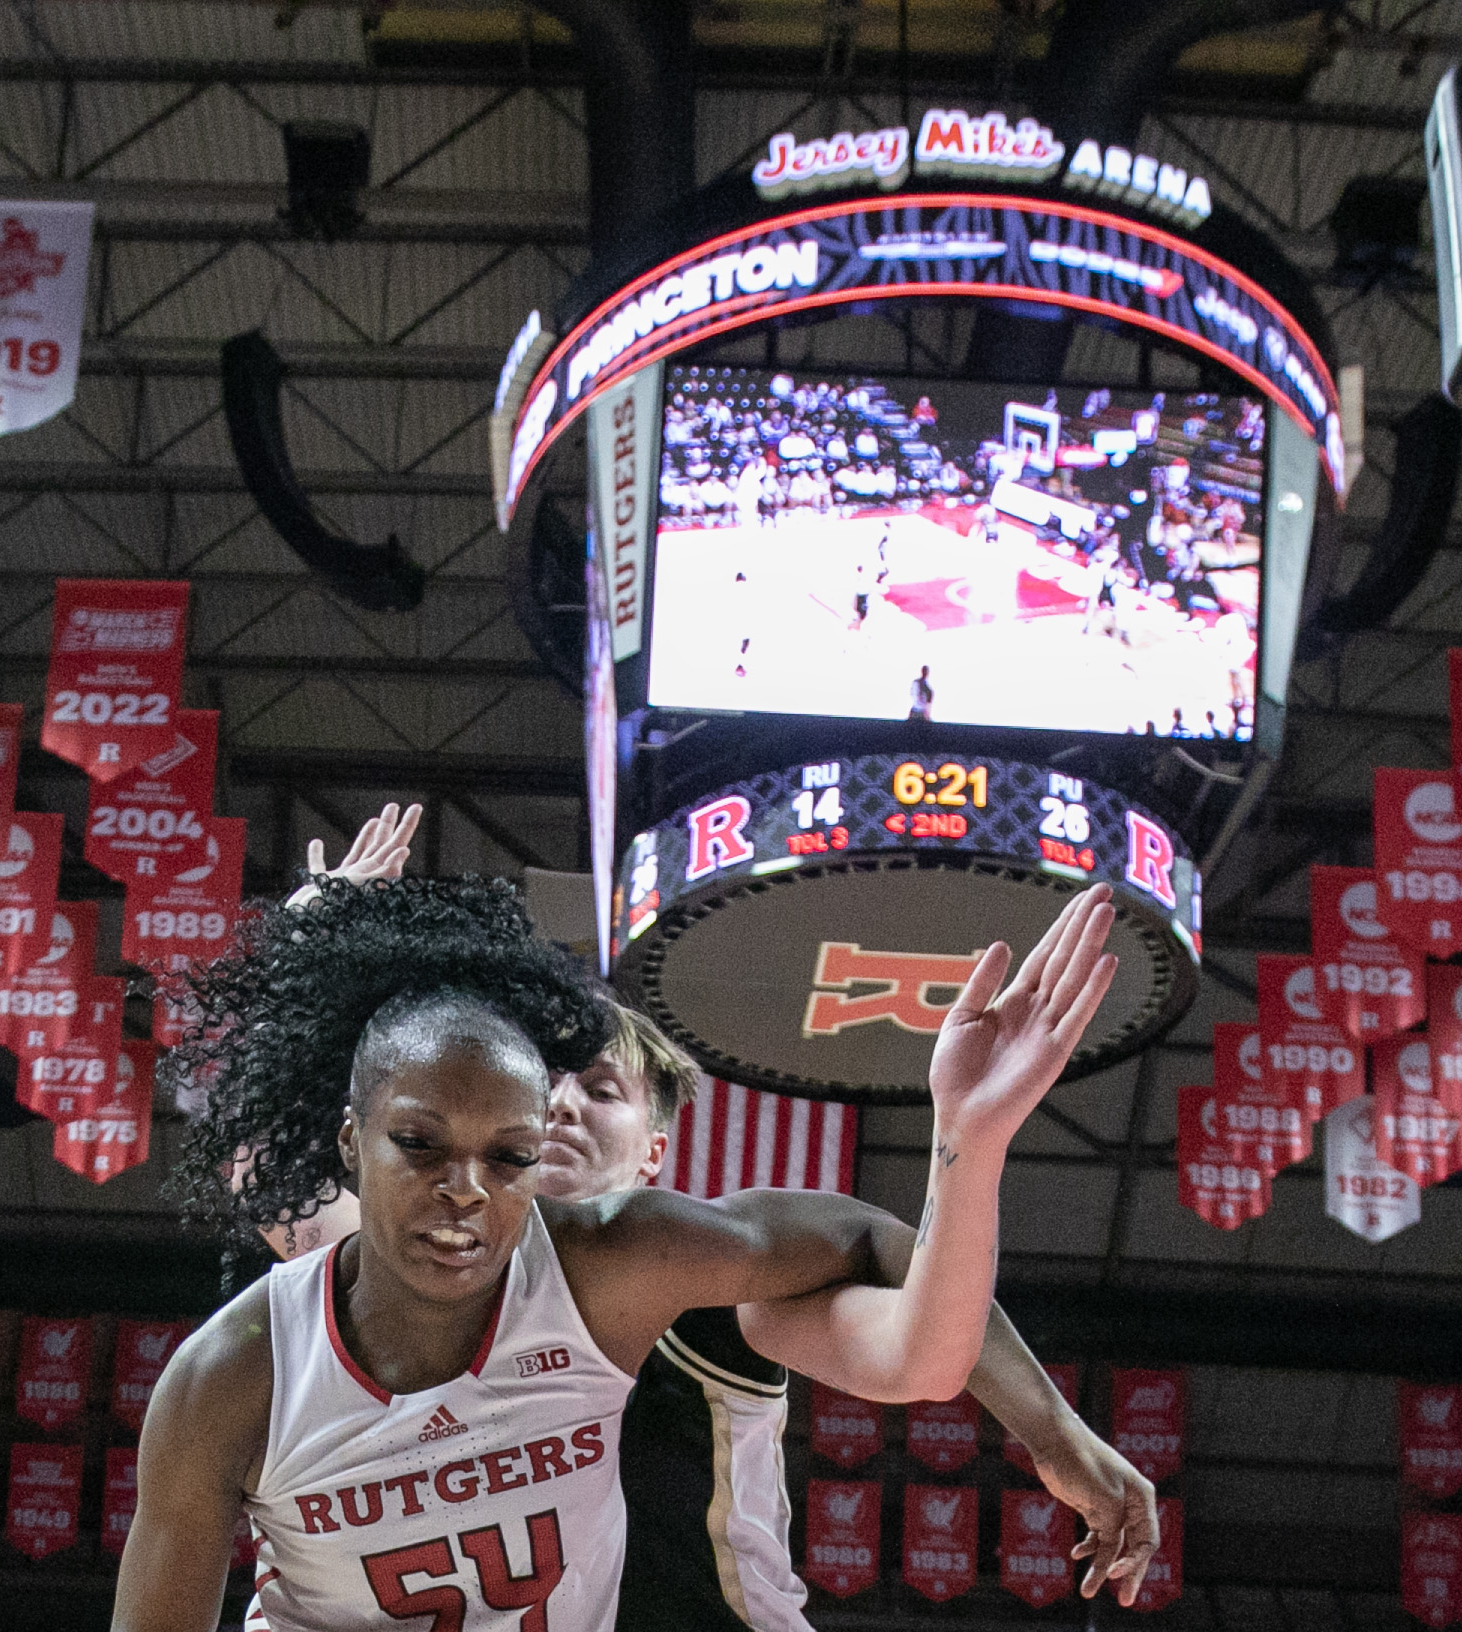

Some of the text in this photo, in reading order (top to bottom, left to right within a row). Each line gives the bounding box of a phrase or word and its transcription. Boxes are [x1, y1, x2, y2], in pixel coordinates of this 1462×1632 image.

[752, 127, 908, 184] Jersey
[1069, 140, 1212, 218] ARENA
[566, 240, 819, 400] PRINCETON
[613, 396, 636, 628] RUTGERS
[52, 690, 171, 724] 2022
[802, 762, 840, 789] RU
[893, 762, 987, 807] 6:21
[1048, 771, 1083, 802] PU
[91, 806, 204, 839] 2004
[791, 786, 844, 829] 14
[1039, 796, 1089, 843] 26
[686, 795, 754, 882] R
[910, 813, 967, 838] 2ND
[1126, 810, 1177, 909] R
[134, 910, 226, 940] 1989
[1322, 963, 1412, 997] 1992
[1267, 1044, 1354, 1075] 1990
[1337, 1175, 1407, 1199] 1982
[418, 1420, 469, 1444] adidas
[294, 1422, 606, 1535] RUTGERS
